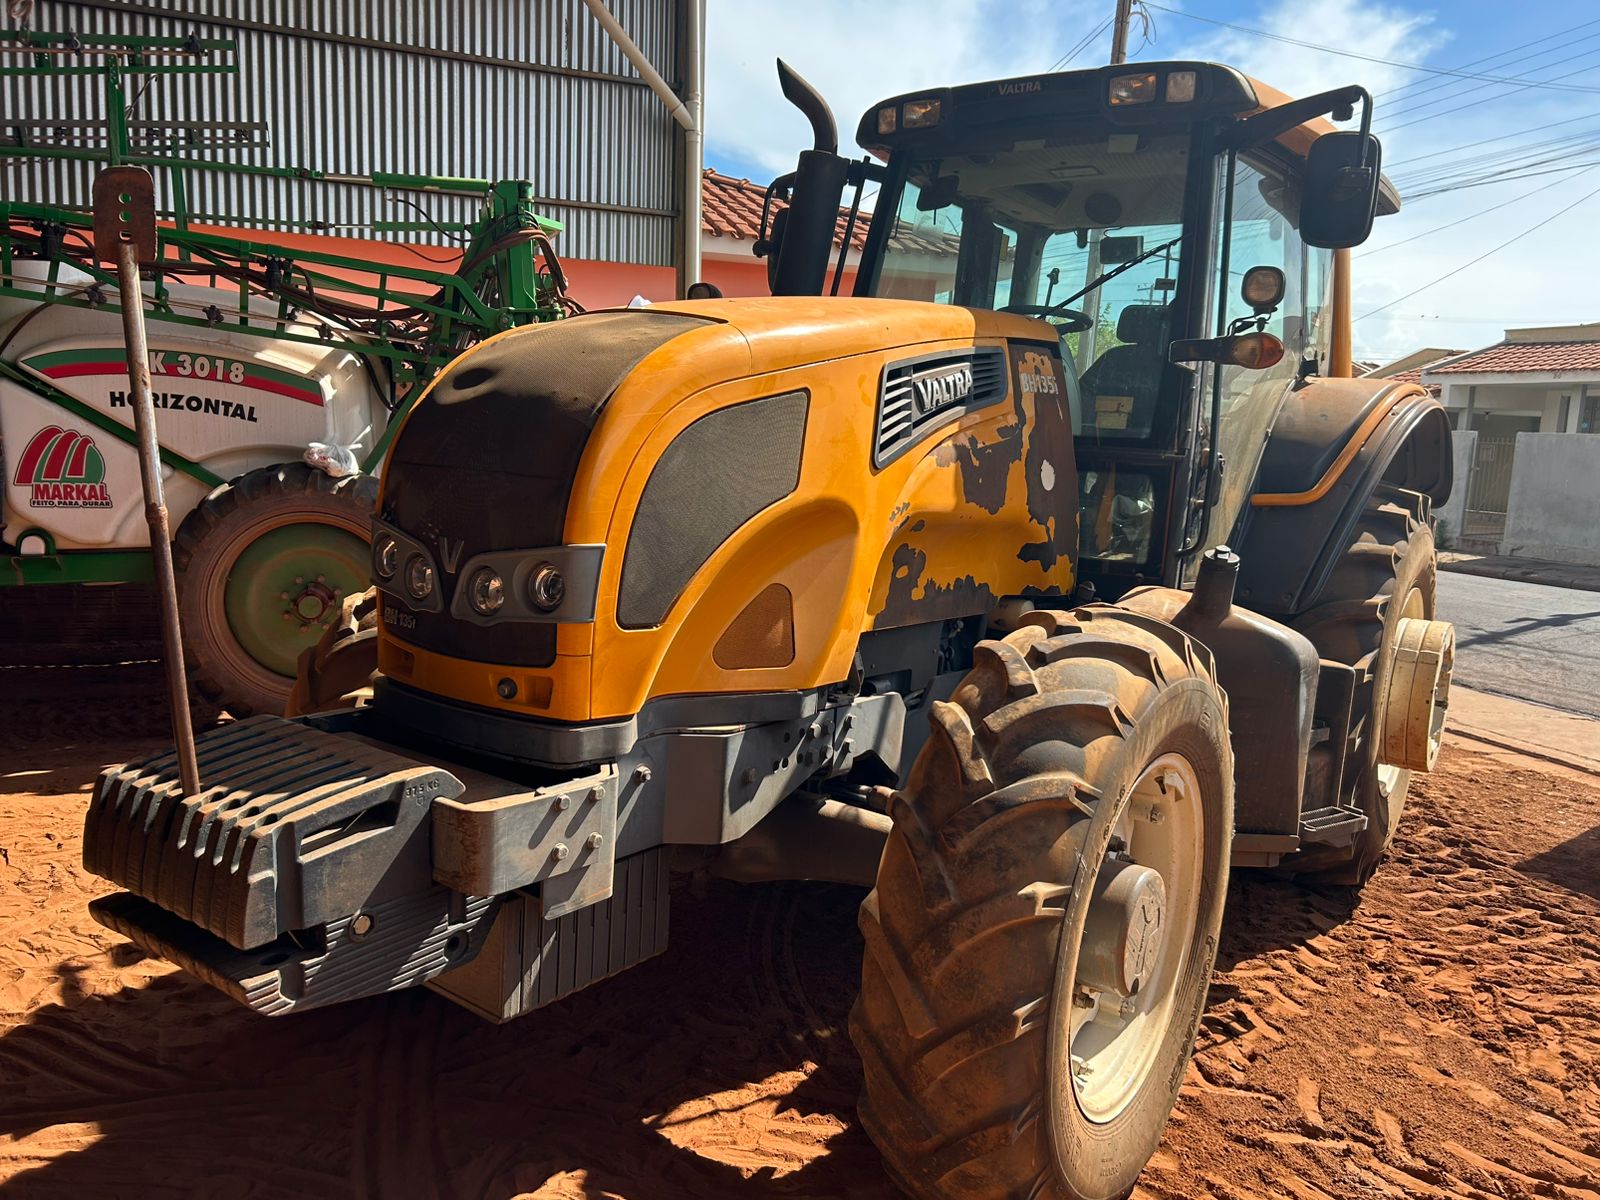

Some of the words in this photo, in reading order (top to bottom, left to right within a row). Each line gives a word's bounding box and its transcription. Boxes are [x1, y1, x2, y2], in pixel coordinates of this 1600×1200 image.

[998, 81, 1041, 96] VALTRA
[177, 353, 245, 384] 3018
[917, 369, 973, 411] VALTRA
[34, 483, 108, 500] MARKAL
